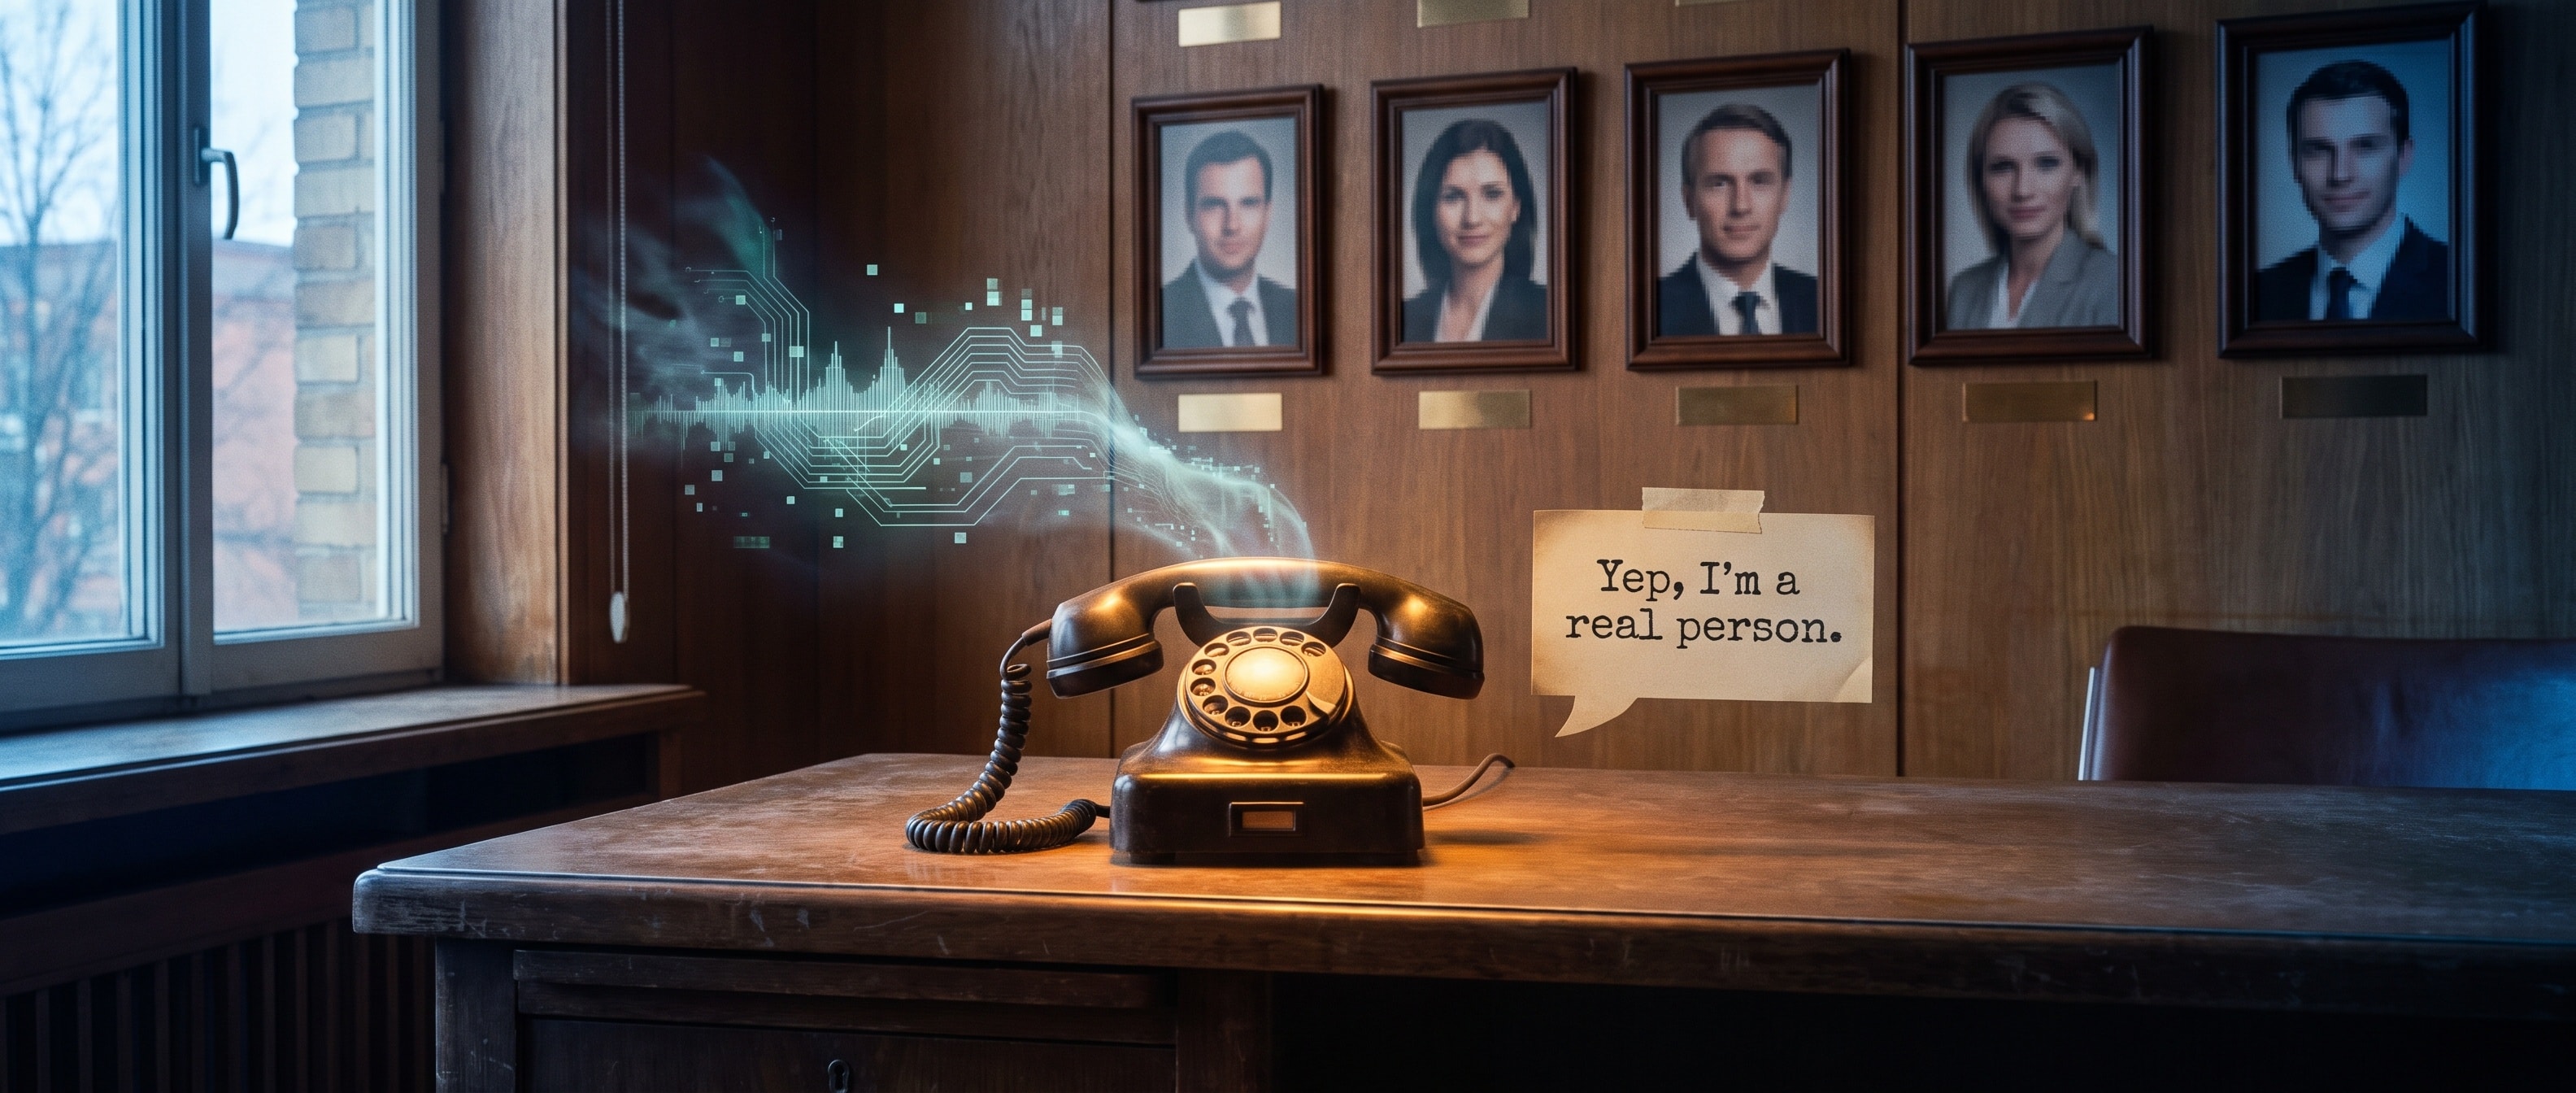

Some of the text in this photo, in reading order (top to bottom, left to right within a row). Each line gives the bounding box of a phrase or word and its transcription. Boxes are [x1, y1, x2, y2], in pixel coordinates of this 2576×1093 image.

[1596, 559, 1800, 602] Yep, I’m a
[1565, 607, 1843, 650] real person.
